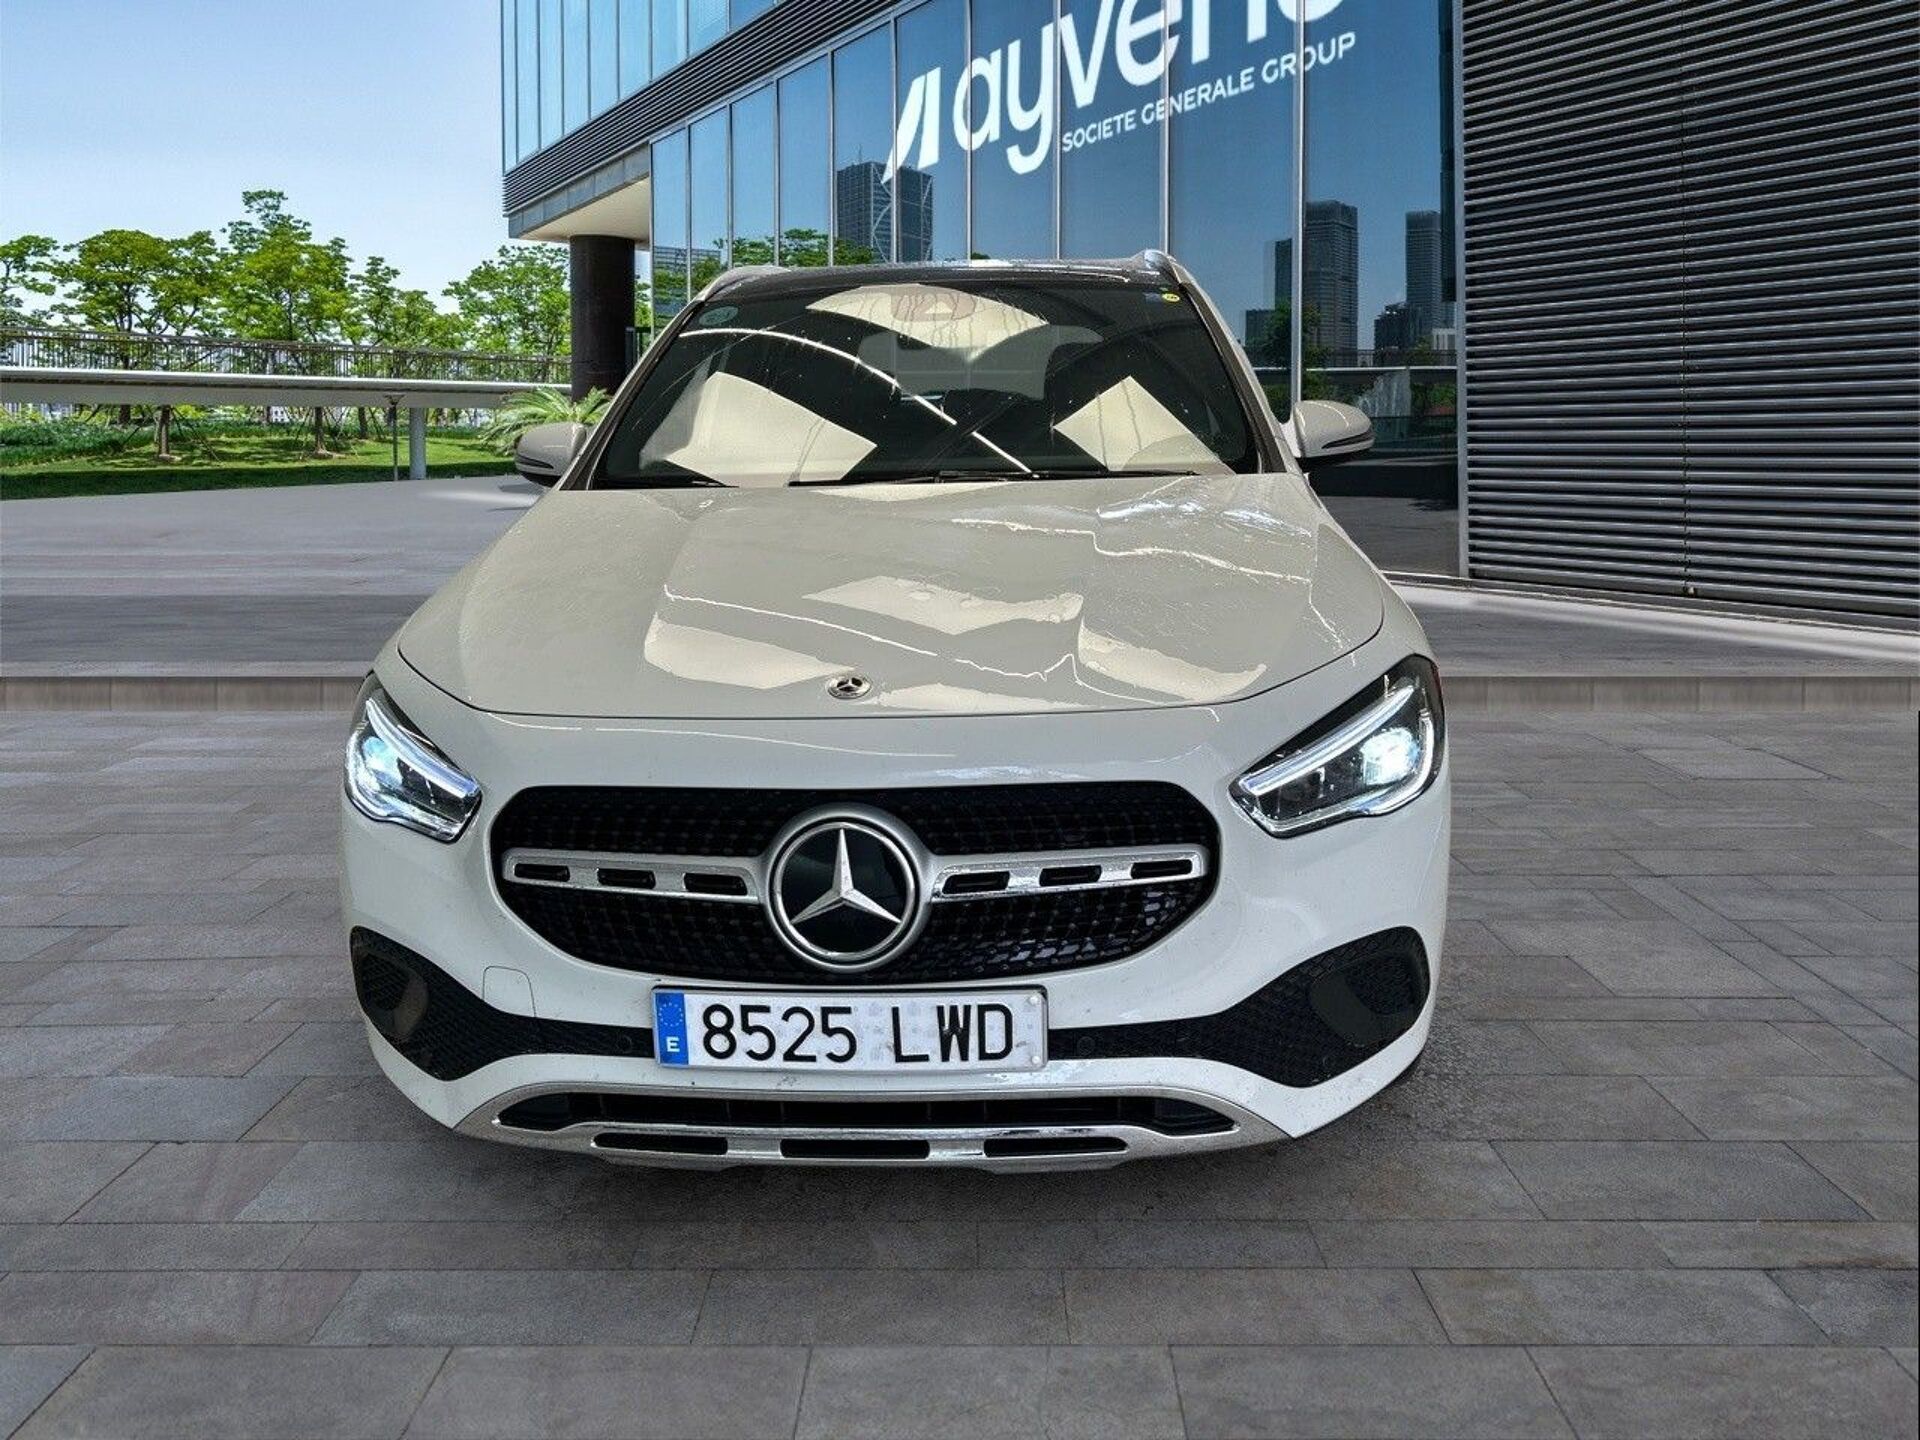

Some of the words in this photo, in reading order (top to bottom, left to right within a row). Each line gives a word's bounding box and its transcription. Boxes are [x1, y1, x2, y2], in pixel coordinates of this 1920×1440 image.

[1061, 109, 1137, 153] SOCIETE
[1140, 66, 1256, 125] GENERALE
[1261, 32, 1356, 84] GROUP
[666, 1036, 680, 1053] E
[702, 1003, 858, 1064] 8525
[891, 1003, 1014, 1063] LWD
